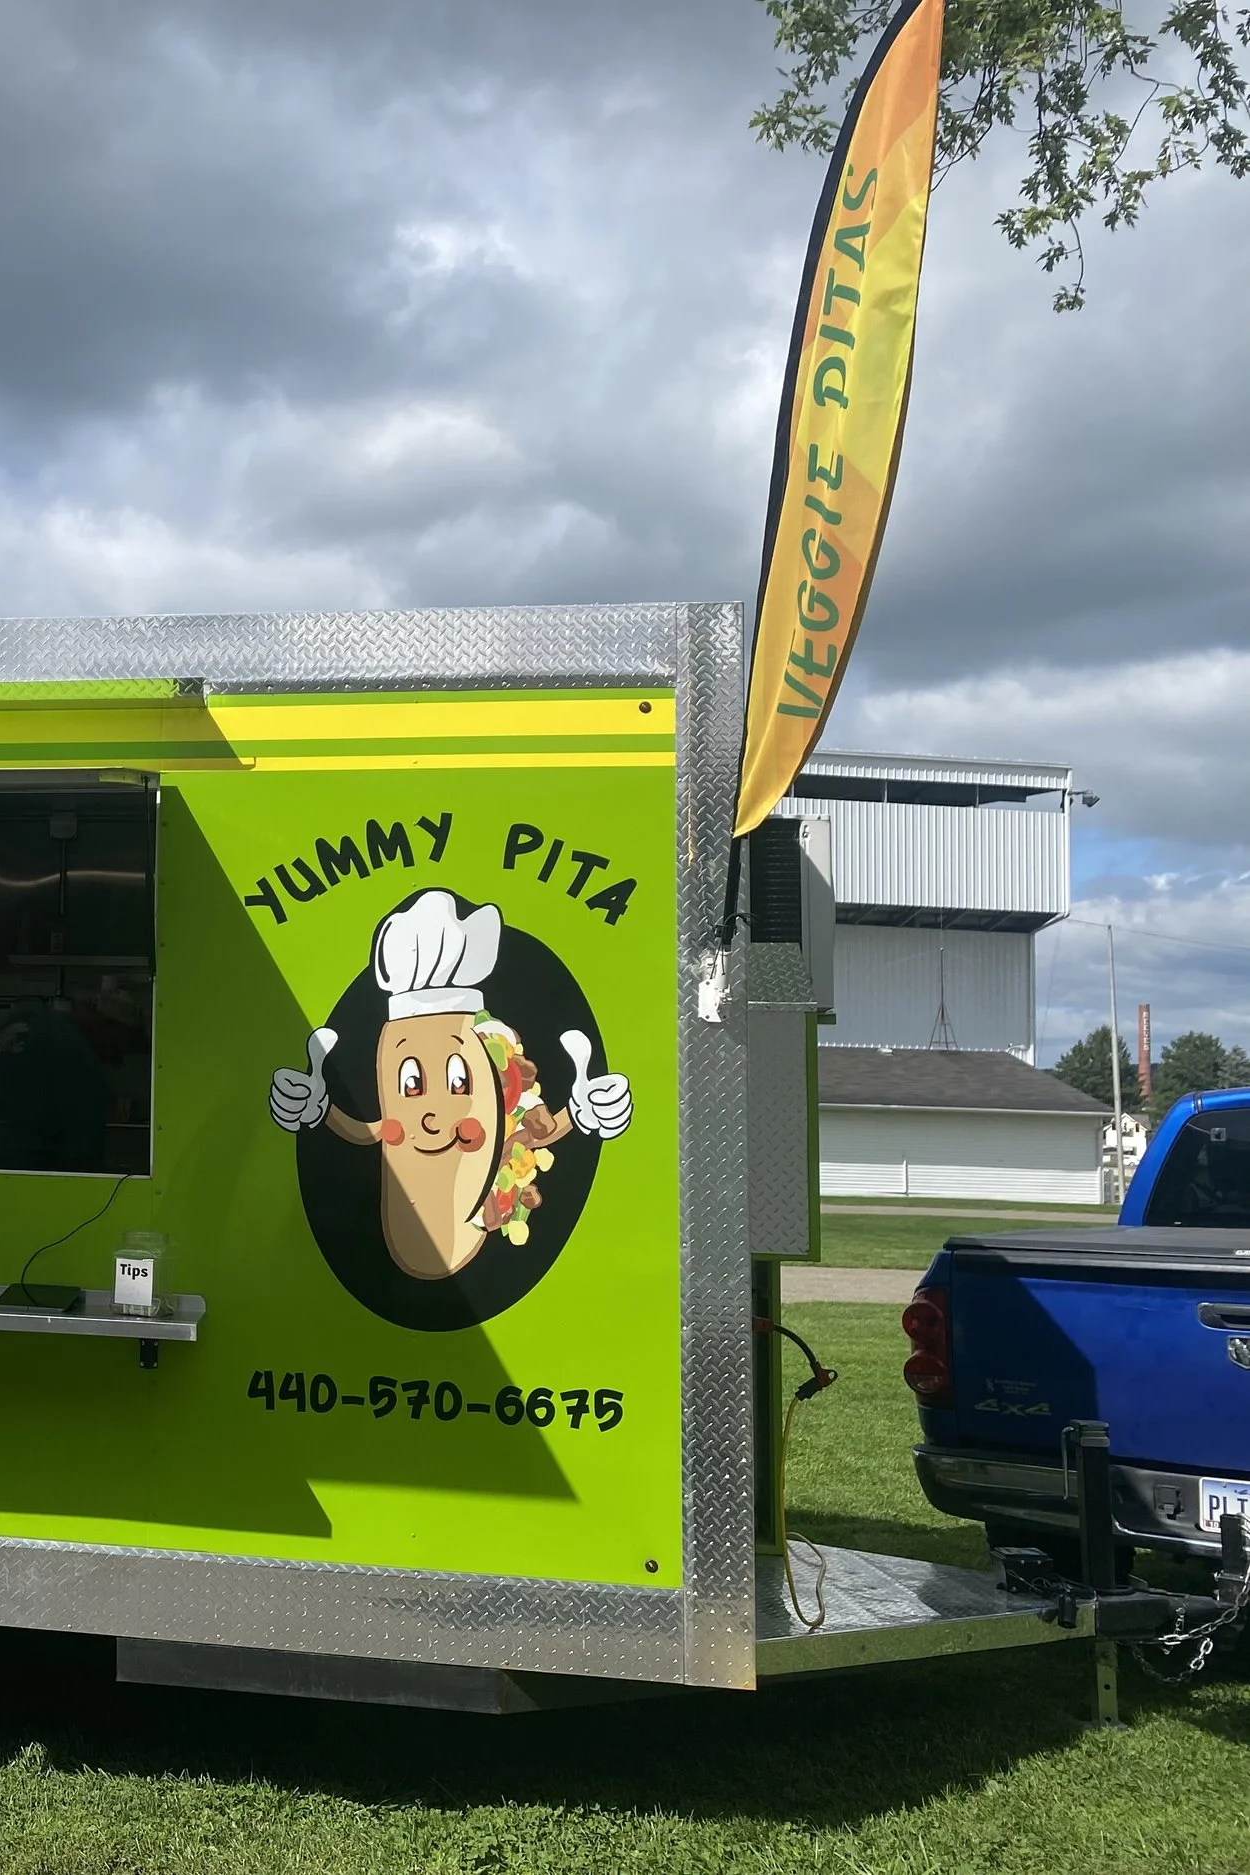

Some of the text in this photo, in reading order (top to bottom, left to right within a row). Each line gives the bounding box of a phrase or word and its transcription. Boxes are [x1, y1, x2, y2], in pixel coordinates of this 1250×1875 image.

[777, 441, 844, 719] VEGGIE
[244, 812, 638, 926] YUMMY PITA
[119, 1263, 149, 1280] Tips
[246, 1369, 625, 1432] 440-570-6675
